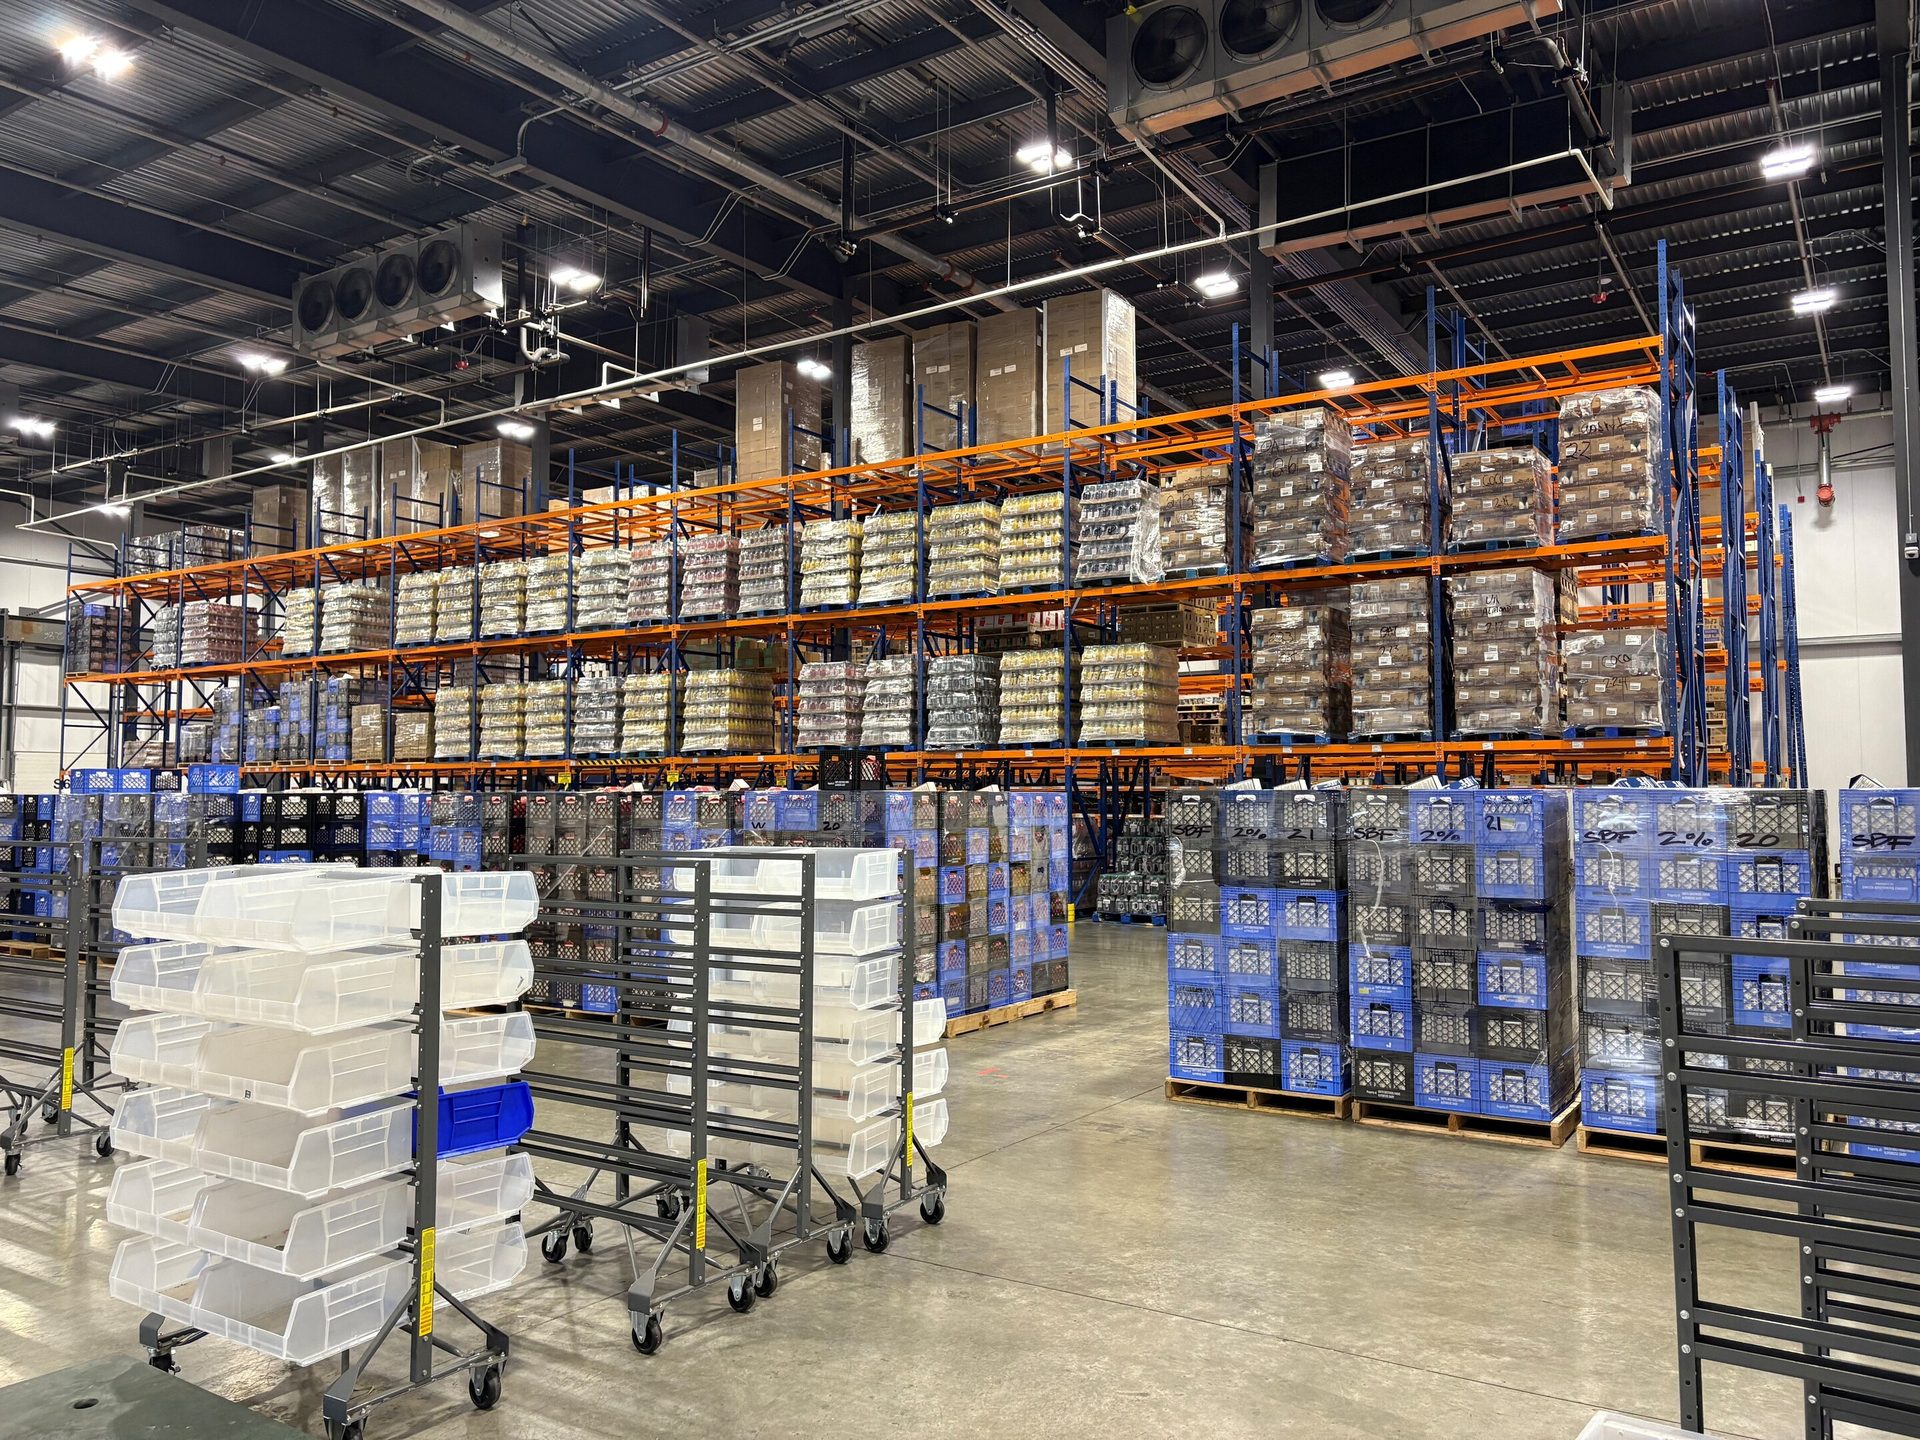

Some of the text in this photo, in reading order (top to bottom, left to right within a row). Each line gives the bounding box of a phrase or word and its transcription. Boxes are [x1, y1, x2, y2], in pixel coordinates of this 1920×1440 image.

[823, 821, 840, 831] 20
[1485, 815, 1502, 831] 21
[1172, 824, 1212, 838] SBF
[1231, 826, 1267, 839] 2%
[1353, 828, 1398, 840] SBF
[1420, 830, 1461, 842] 2%
[1658, 831, 1714, 847] 2%
[1737, 833, 1780, 848] 20
